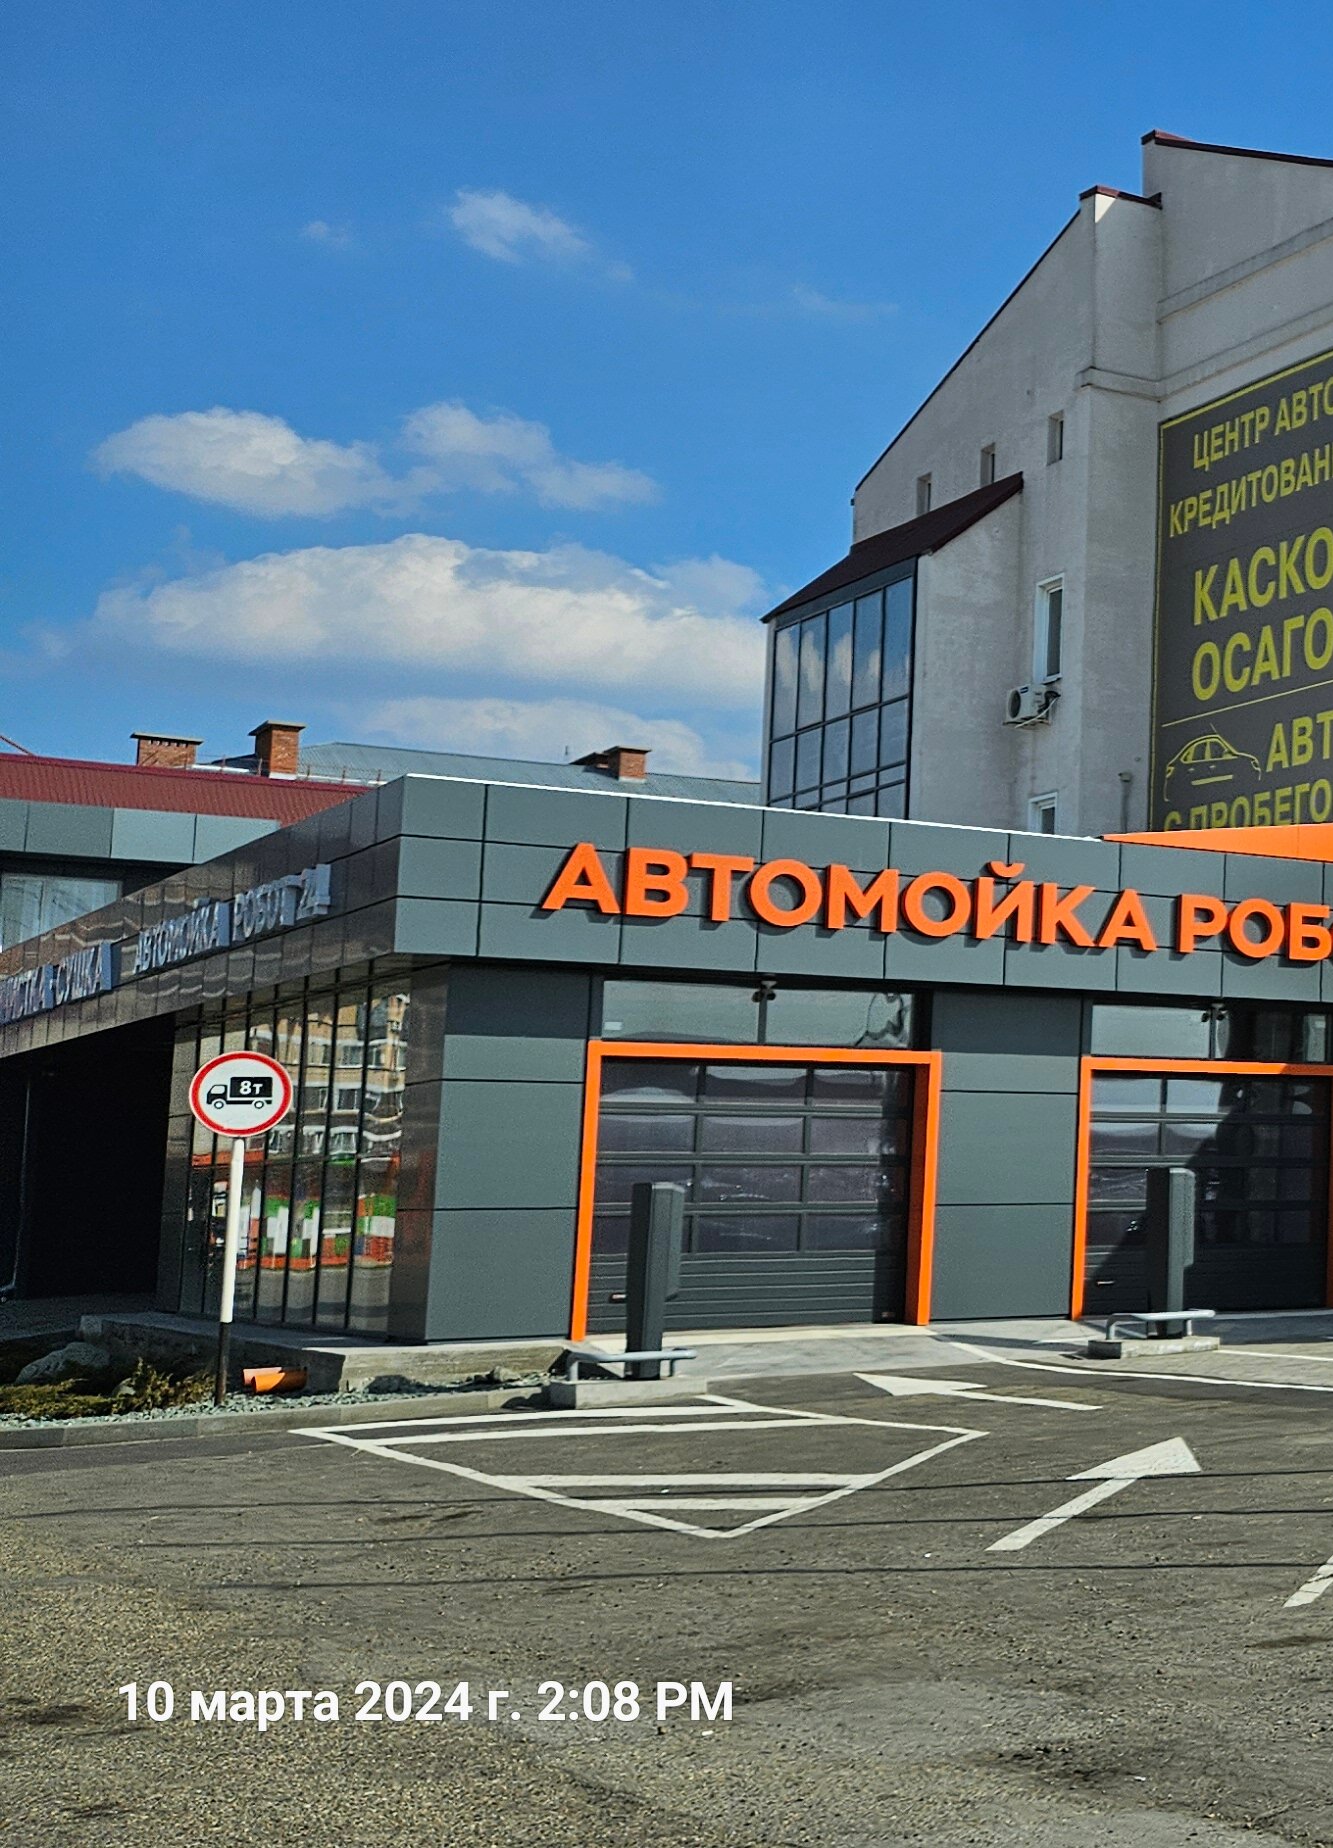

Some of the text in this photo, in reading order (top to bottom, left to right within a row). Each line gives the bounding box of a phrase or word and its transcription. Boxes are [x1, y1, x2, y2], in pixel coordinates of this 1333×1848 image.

[1193, 406, 1270, 472] ЦЕНТР
[232, 874, 303, 942] РОБОТ
[541, 841, 1157, 952] АВТОМОЙКА
